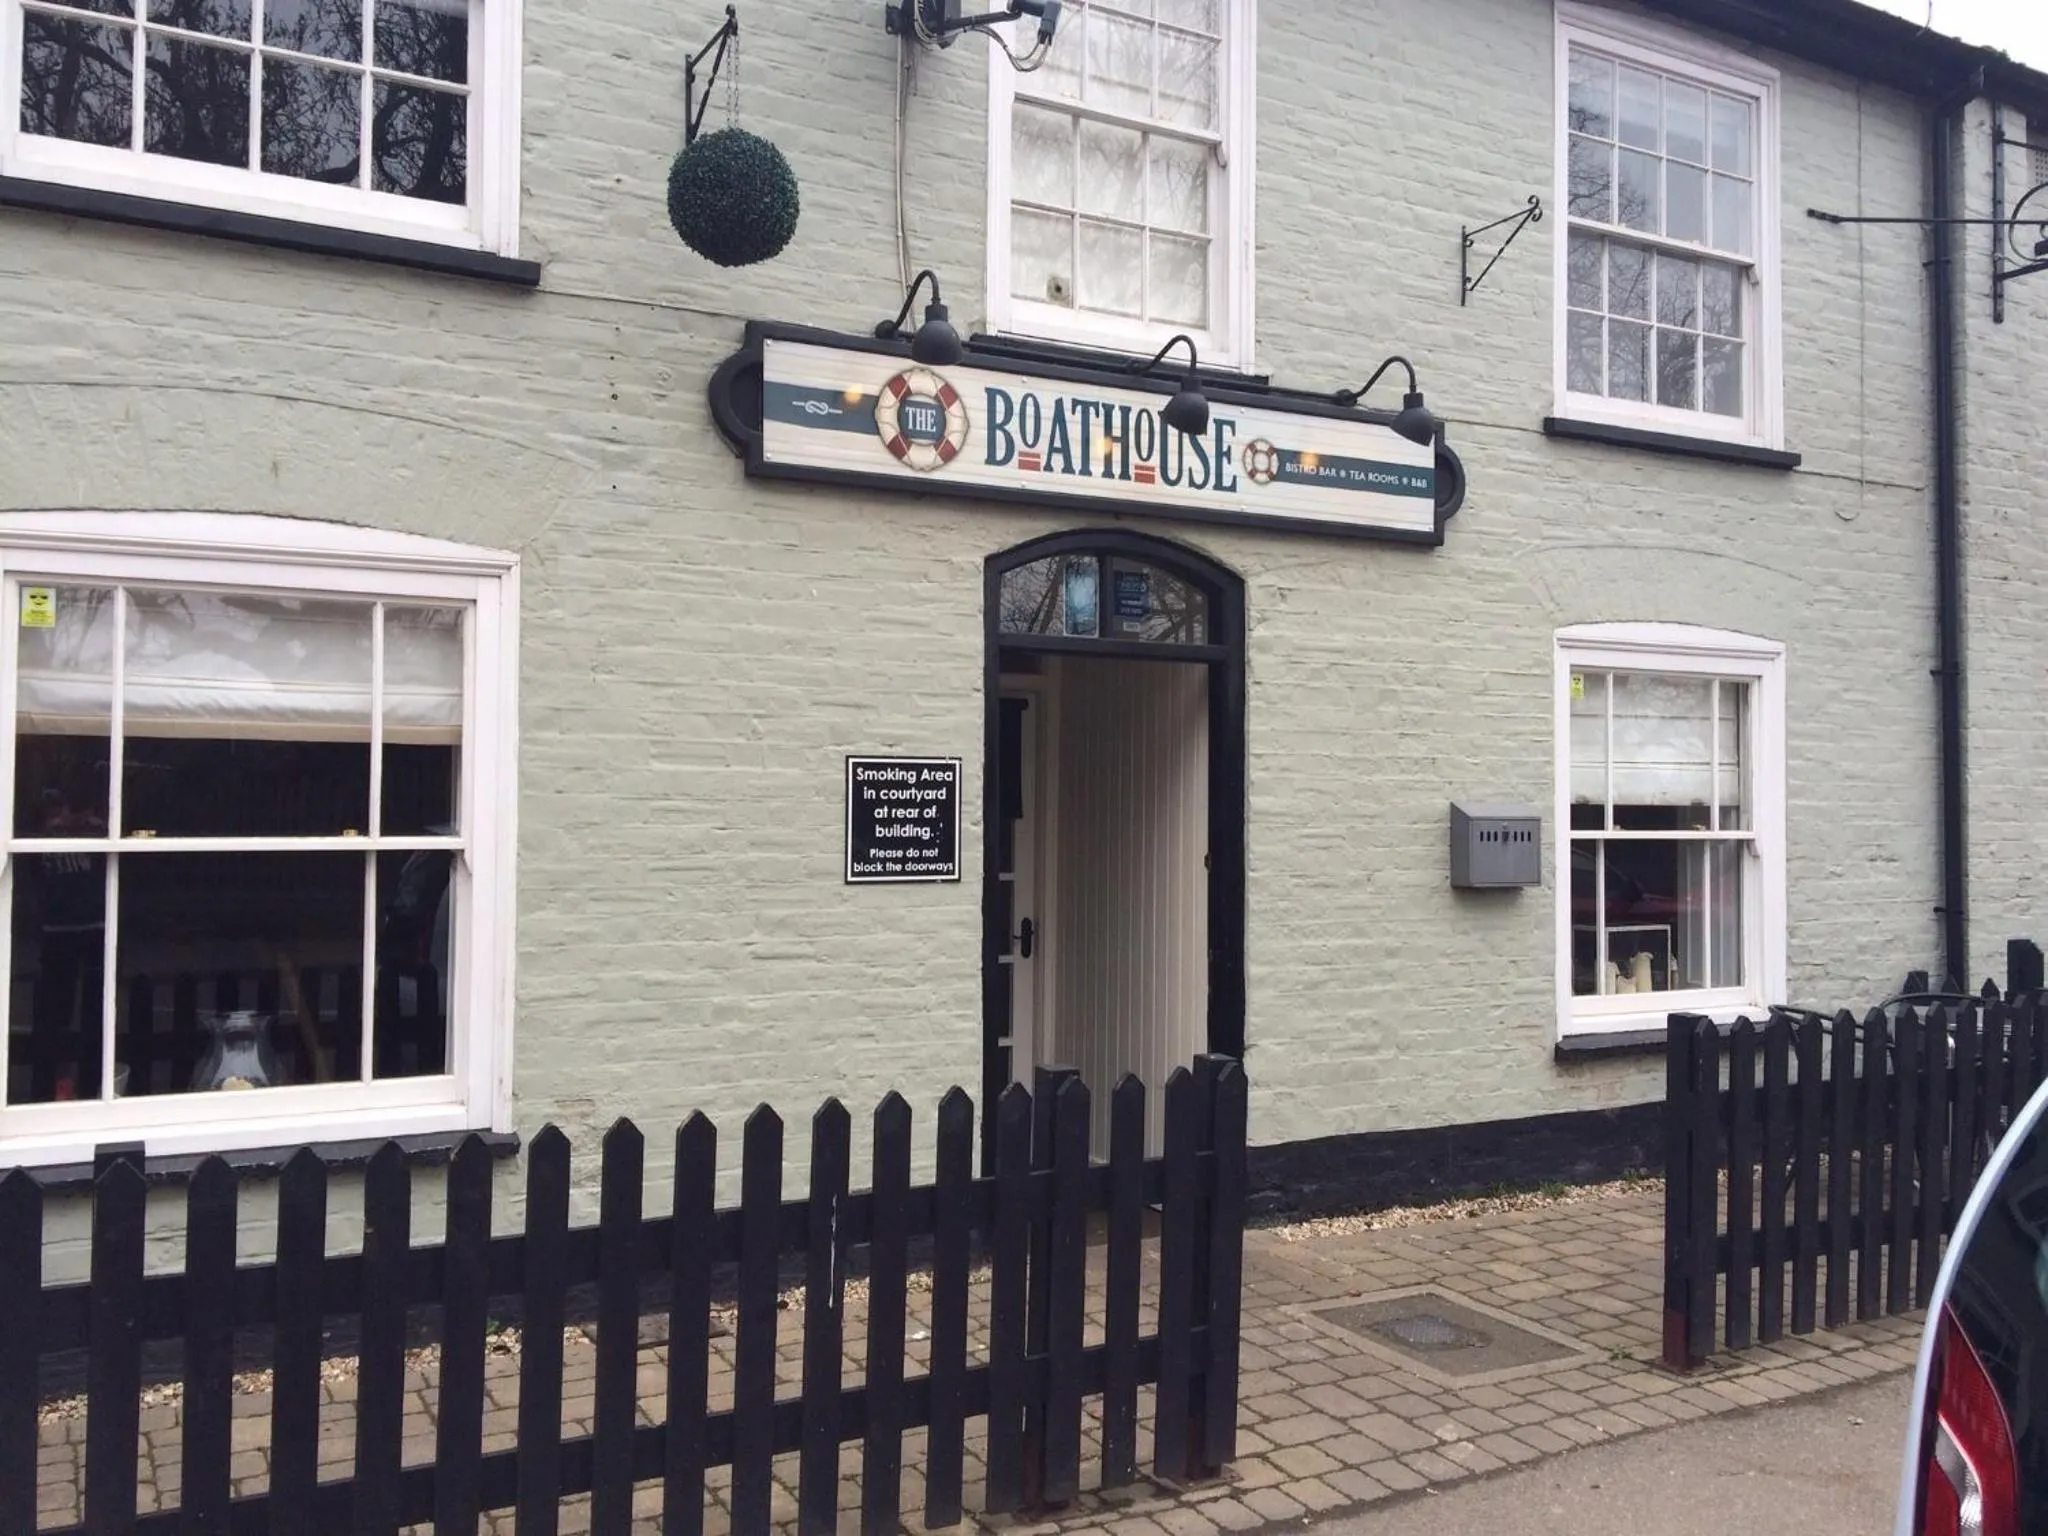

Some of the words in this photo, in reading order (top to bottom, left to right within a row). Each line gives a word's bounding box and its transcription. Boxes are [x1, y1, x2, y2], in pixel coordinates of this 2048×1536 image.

[905, 406, 937, 433] THE
[984, 386, 1238, 493] BOATHOUSE
[1319, 465, 1336, 477] BAR
[1349, 470, 1366, 481] TEA
[1367, 472, 1400, 485] ROOMS
[856, 767, 917, 784] Smoking
[920, 768, 954, 781] Area
[863, 786, 876, 800] in
[879, 787, 947, 803] courtyard
[874, 805, 888, 819] at
[891, 808, 920, 819] rear
[923, 805, 937, 819] of
[875, 824, 935, 840] building.
[869, 848, 904, 859] Please
[906, 847, 920, 858] do
[922, 847, 939, 858] not
[853, 862, 884, 873] block
[885, 862, 903, 873] the
[904, 861, 954, 873] doorways
